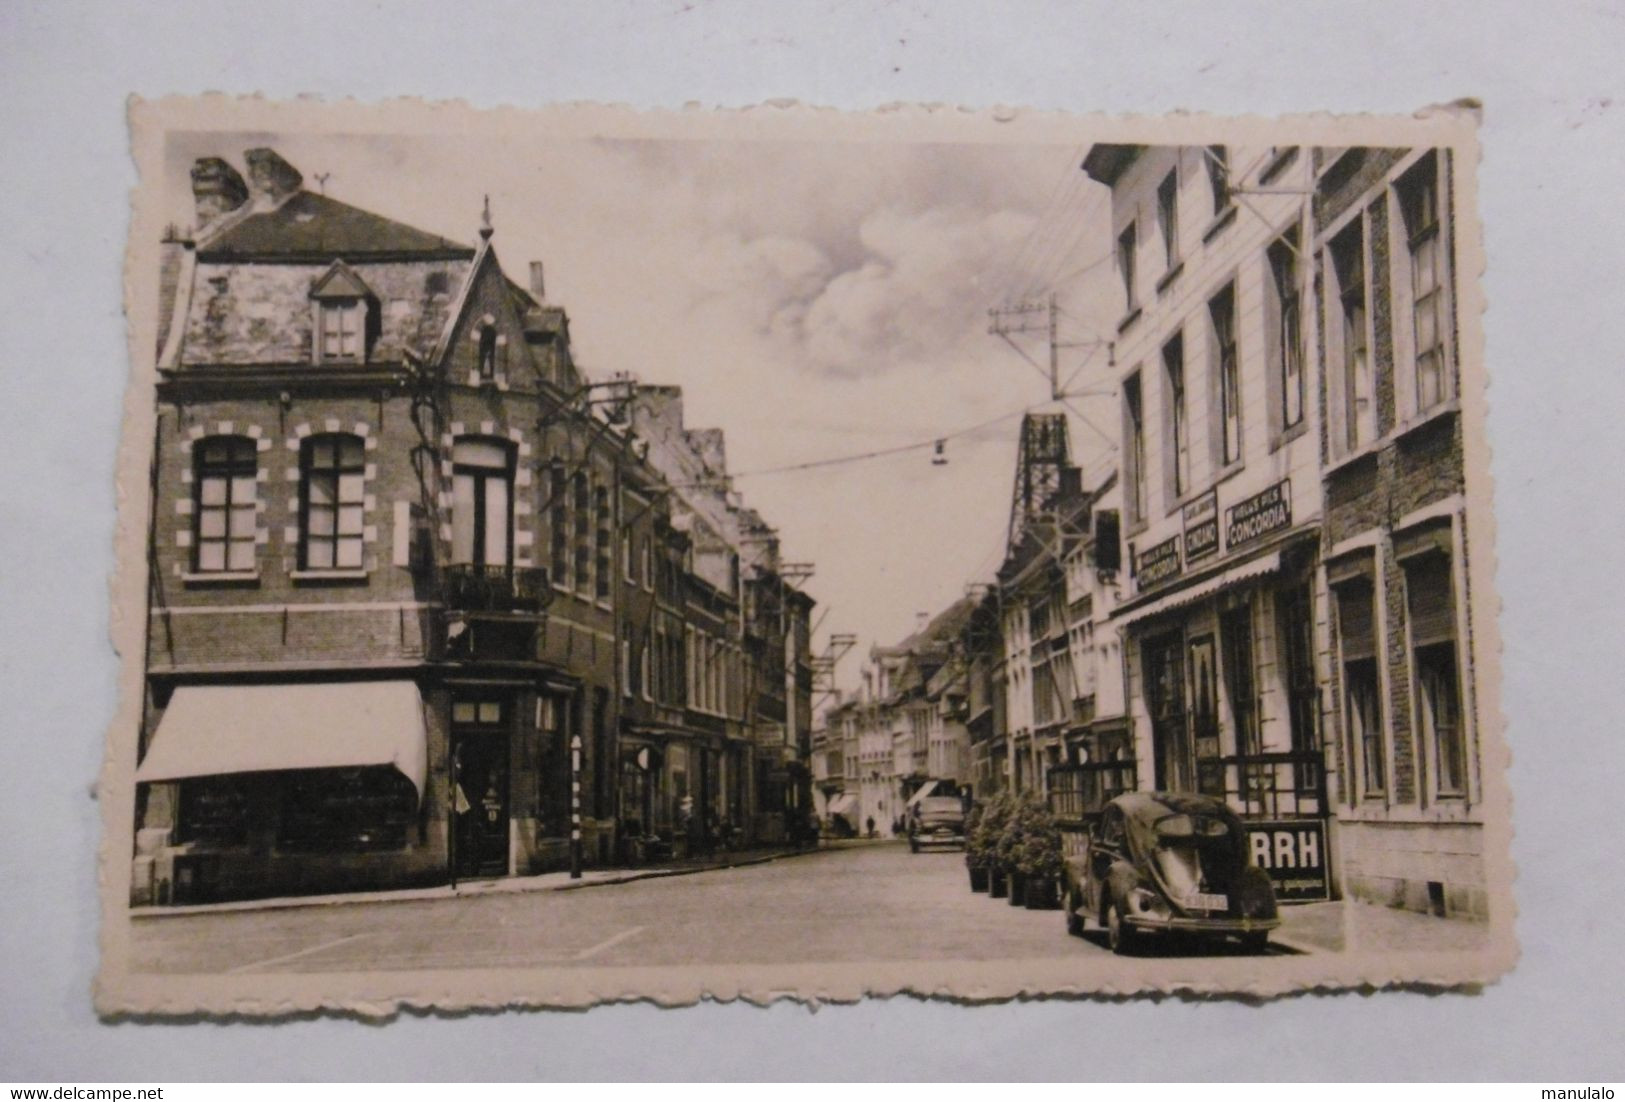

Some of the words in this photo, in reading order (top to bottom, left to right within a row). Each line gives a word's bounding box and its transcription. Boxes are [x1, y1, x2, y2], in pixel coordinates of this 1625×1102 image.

[1186, 522, 1217, 552] CINZANO
[1231, 503, 1286, 545] CONCORDIA
[1248, 831, 1319, 869] RRH
